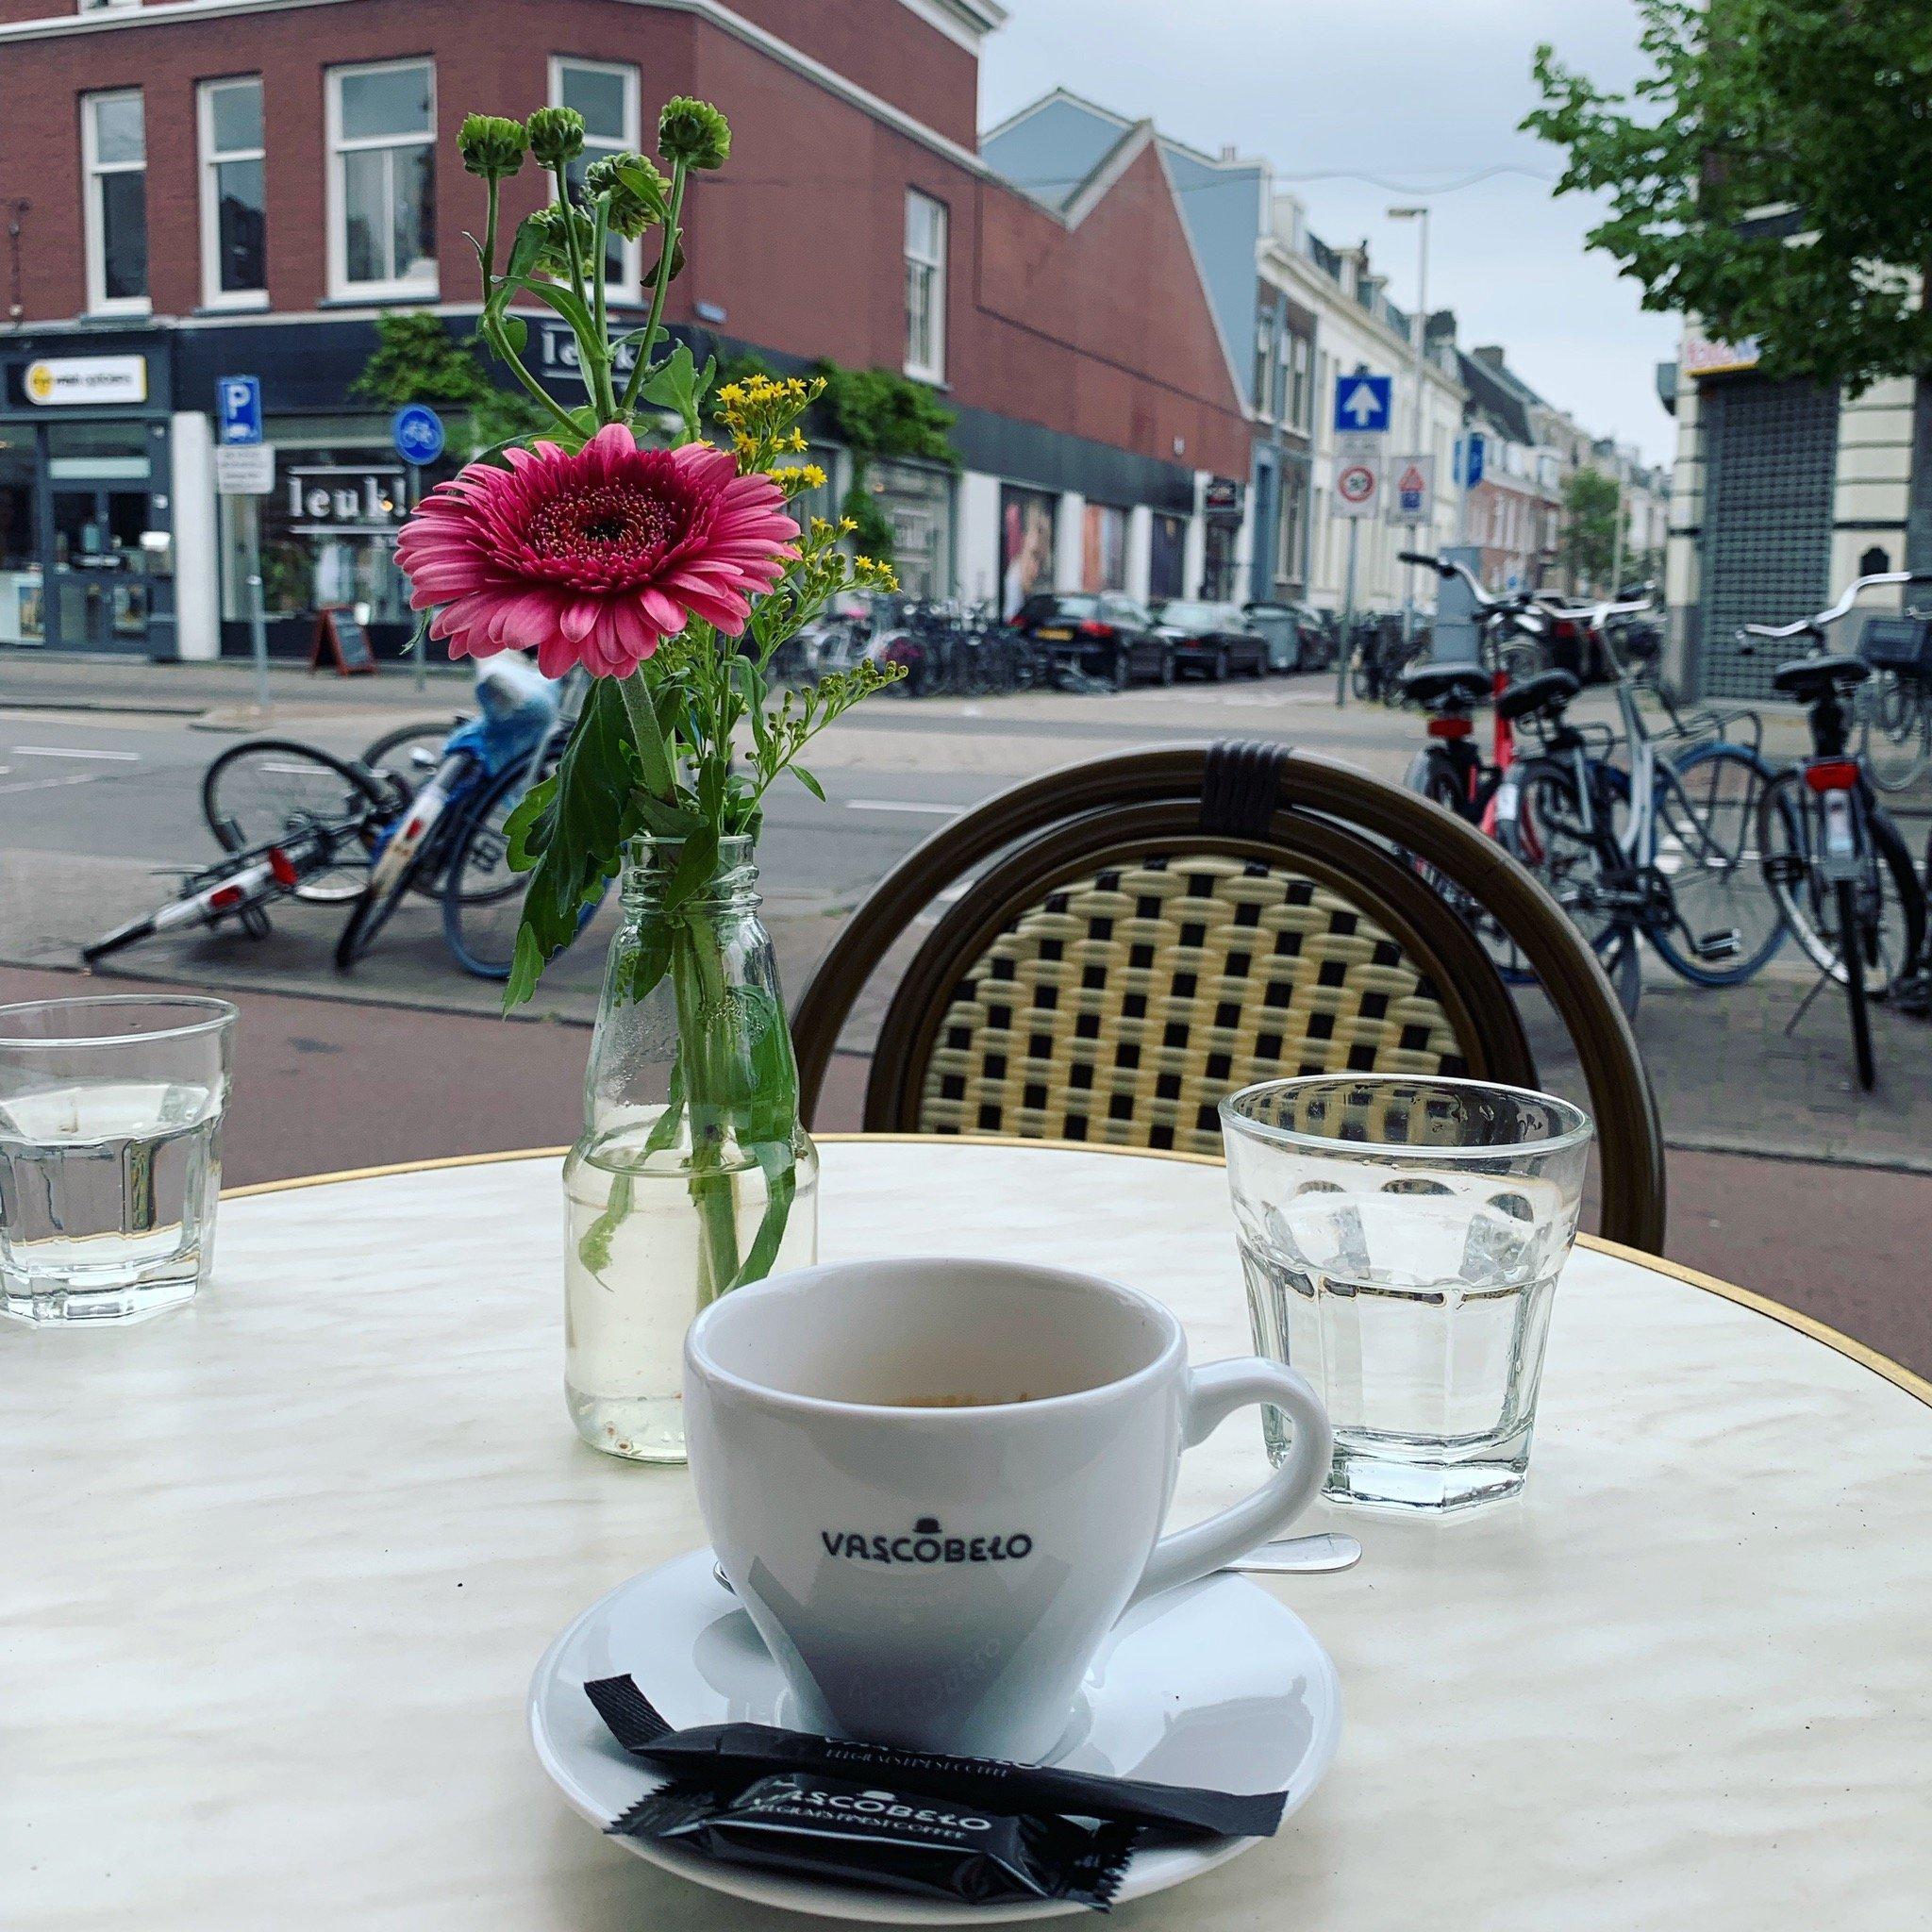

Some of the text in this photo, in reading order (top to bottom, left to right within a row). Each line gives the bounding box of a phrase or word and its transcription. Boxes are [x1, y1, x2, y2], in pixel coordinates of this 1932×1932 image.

[541, 331, 638, 370] lek
[227, 384, 251, 420] P
[287, 475, 406, 519] leuk!
[821, 1529, 1033, 1564] VASCOBELO
